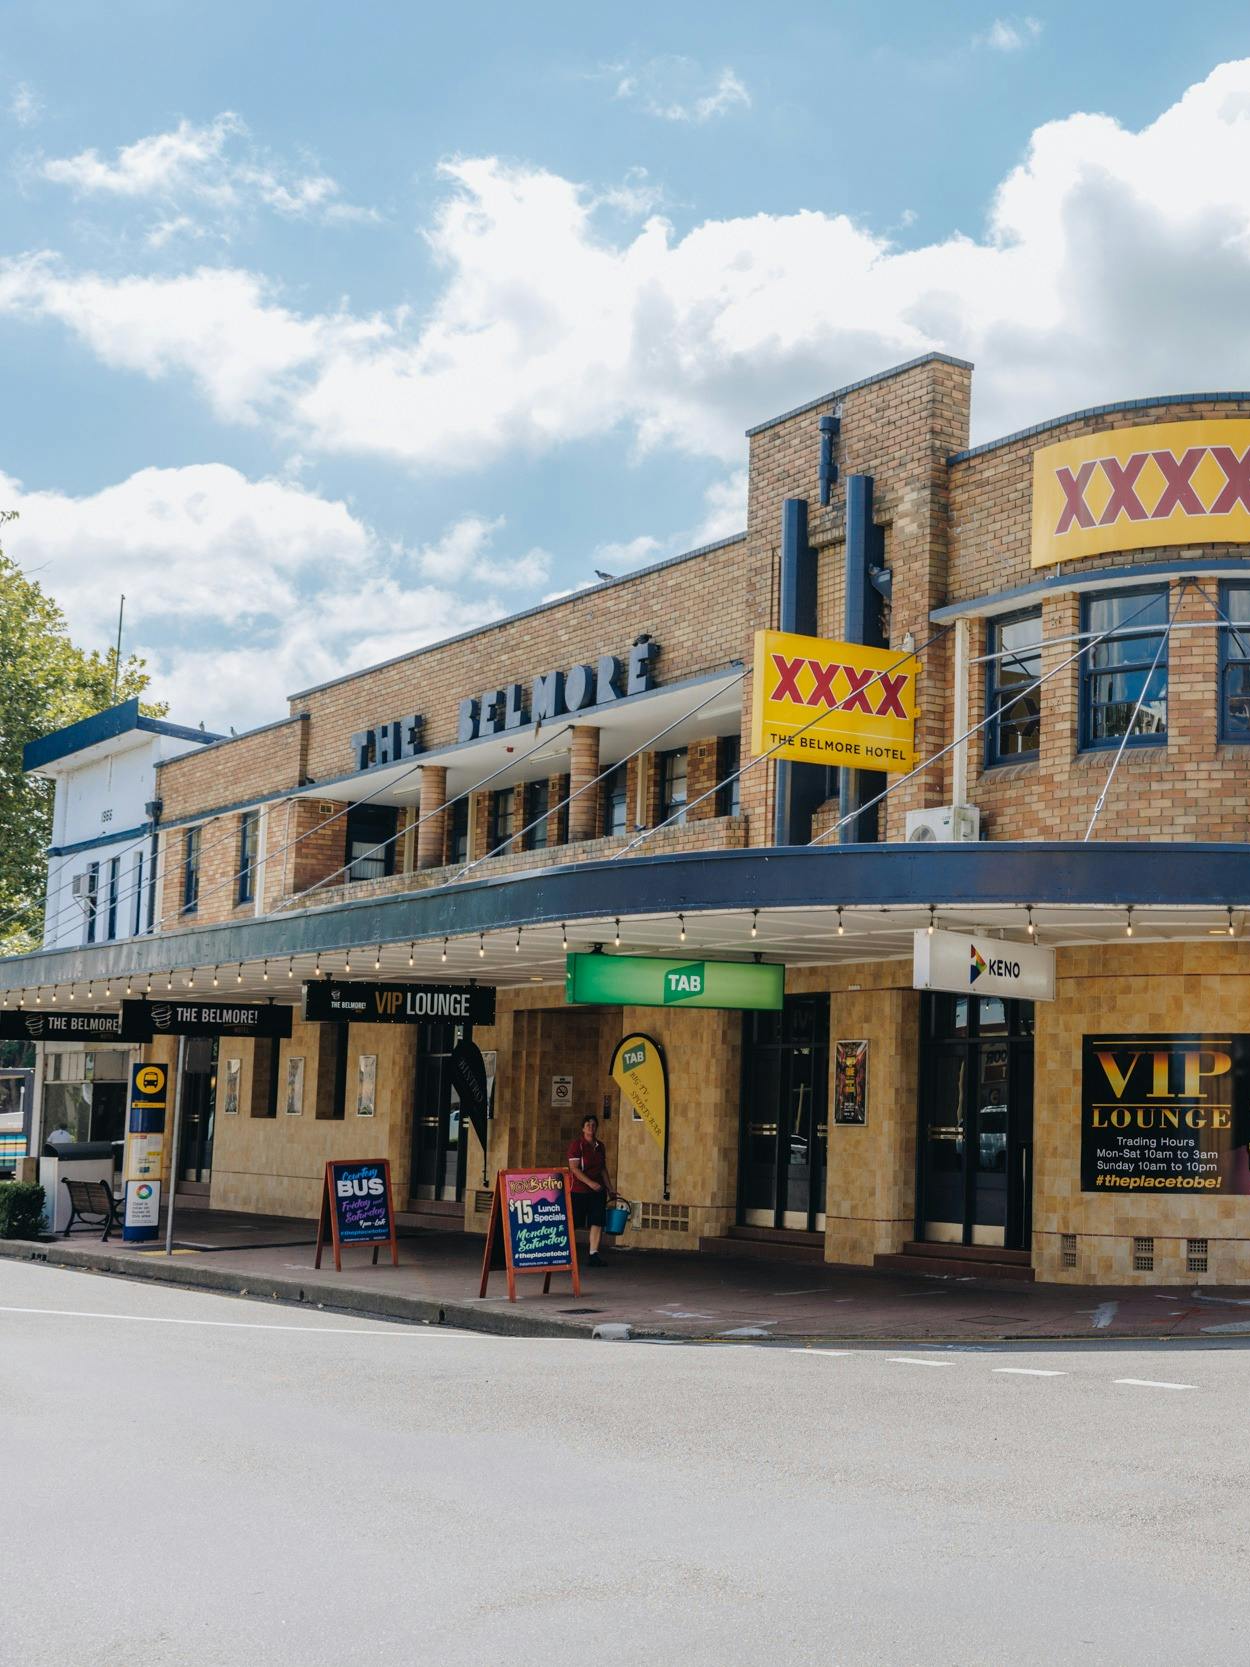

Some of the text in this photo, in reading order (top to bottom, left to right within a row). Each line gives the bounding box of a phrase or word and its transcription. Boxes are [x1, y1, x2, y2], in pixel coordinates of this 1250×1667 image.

[769, 653, 910, 720] XXXX
[352, 642, 660, 770] THE BELMORE
[770, 733, 907, 761] THE BELMORE HOTEL
[989, 959, 1021, 978] KENO
[668, 974, 701, 992] TAB
[375, 991, 471, 1016] VIP LOUNGE
[48, 1017, 67, 1030] THE
[176, 1007, 258, 1024] THE BELMORE!
[624, 1051, 645, 1065] TAB
[1093, 1051, 1232, 1099] VIP
[1092, 1107, 1232, 1129] LOUNGE
[1116, 1136, 1195, 1148] Trading Hours
[1096, 1149, 1218, 1159] Mon-Sat 10am to 3am
[1096, 1161, 1218, 1173] Sunday 10am to 10pm
[336, 1178, 385, 1197] BUS
[528, 1175, 563, 1194] Bistro
[1096, 1175, 1222, 1189] #theplacetobe!
[341, 1198, 371, 1213] Friday
[509, 1198, 533, 1225] $15
[538, 1204, 561, 1213] Lunch
[345, 1206, 386, 1223] Saturday
[534, 1213, 566, 1223] Specials
[516, 1225, 557, 1241] Monday
[518, 1234, 567, 1252] Saturday
[514, 1250, 569, 1260] #theplacetobe!
